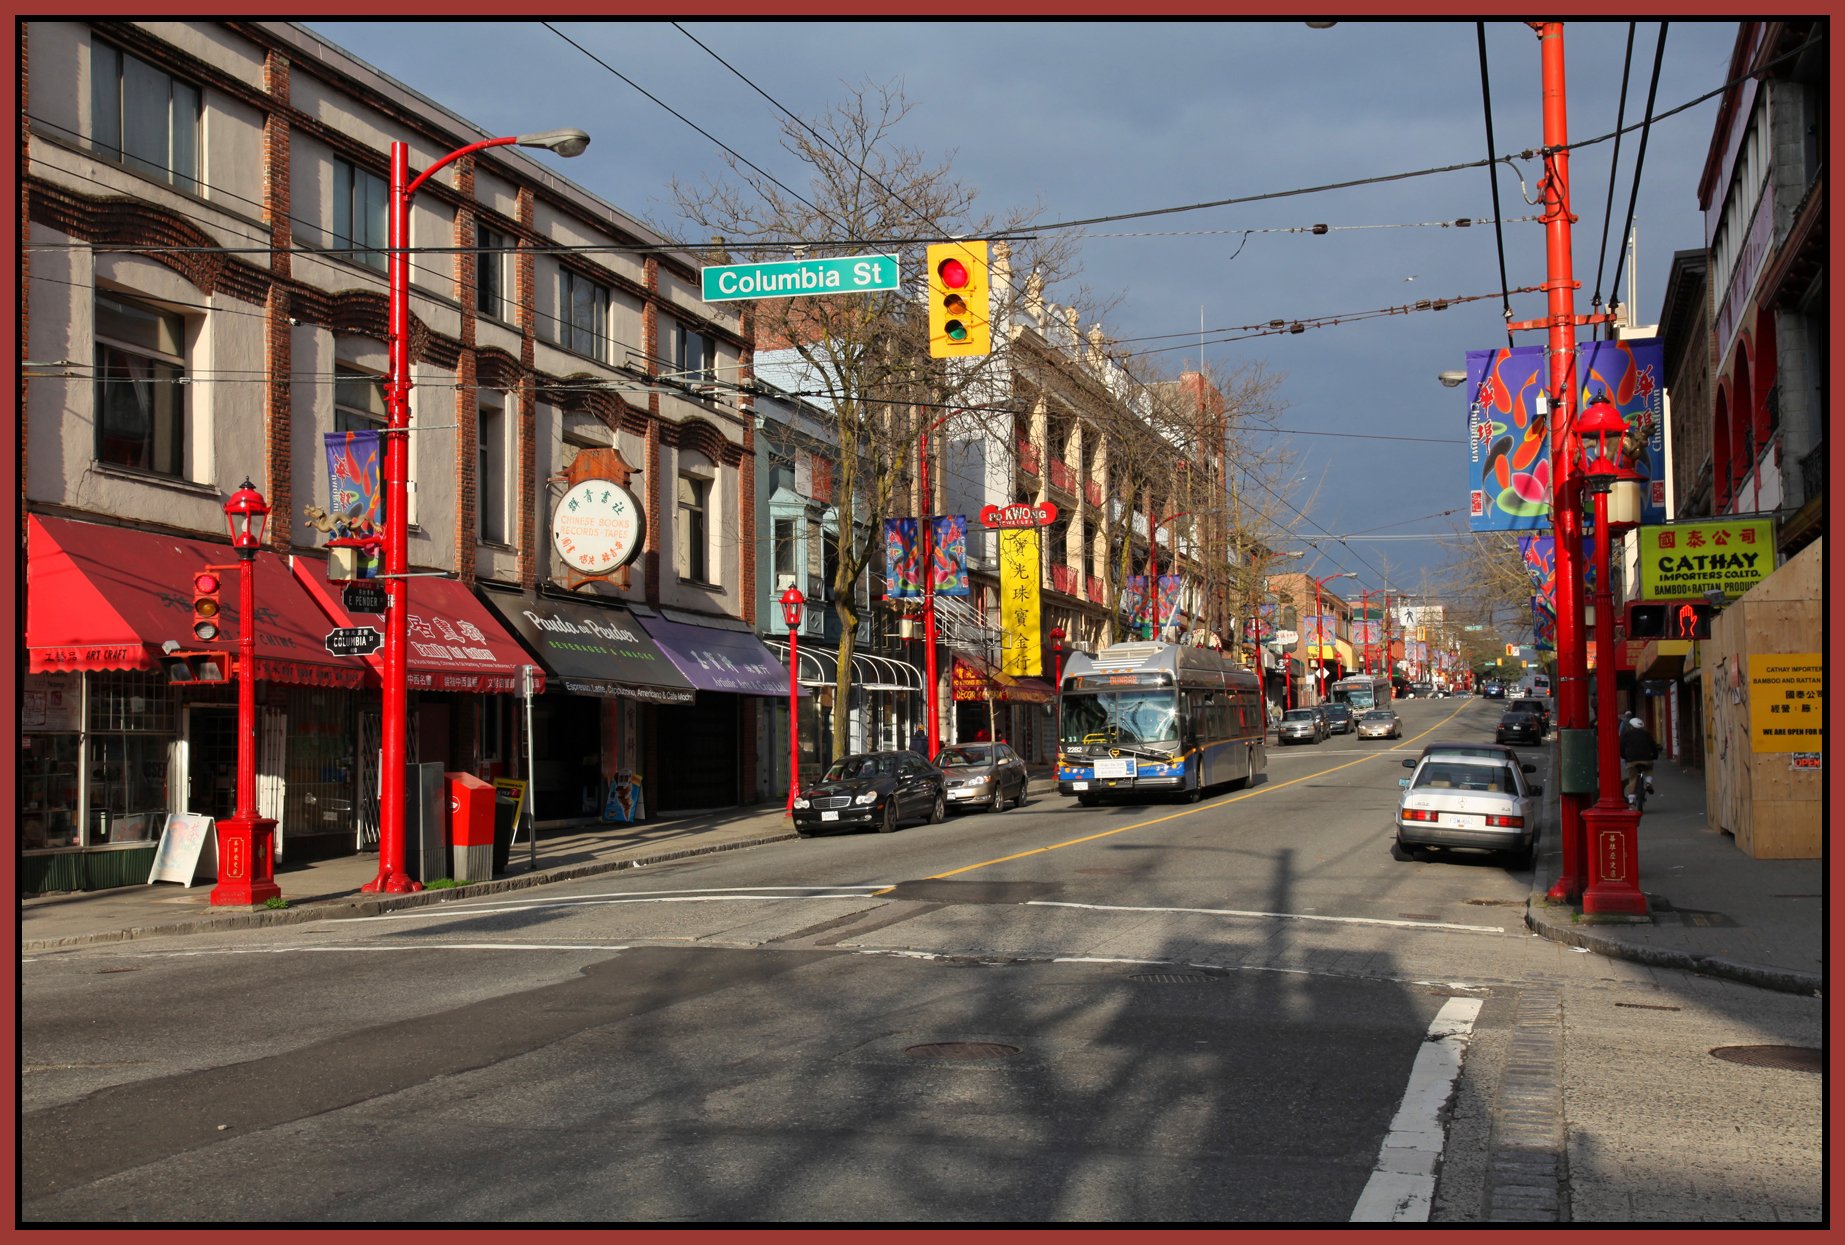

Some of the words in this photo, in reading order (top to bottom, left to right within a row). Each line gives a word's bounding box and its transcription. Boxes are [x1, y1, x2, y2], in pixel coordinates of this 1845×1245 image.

[718, 265, 840, 295] Columbia
[853, 262, 882, 286] St
[1652, 388, 1662, 452] Chinatown
[1471, 401, 1479, 463] Chinatown
[1005, 506, 1047, 522] KWONG
[560, 515, 595, 526] CHINESE
[599, 518, 630, 529] BOOKS
[560, 525, 599, 537] RECORDS
[604, 529, 628, 539] TAPES
[1658, 528, 1756, 549] 國泰公司
[1658, 552, 1759, 573] CATHAY
[1659, 571, 1723, 582] IMPORTERS
[1654, 584, 1687, 595] BAMBOO
[1724, 581, 1760, 593] PRODUC
[355, 596, 378, 607] PENDER
[523, 610, 580, 635] Panda
[577, 624, 593, 635] on
[583, 619, 640, 643] Pender
[333, 636, 367, 648] COLUMBIA
[86, 650, 101, 661] ART
[103, 649, 128, 661] CRAFT
[547, 640, 608, 655] BEVERAGES
[619, 650, 655, 661] SNACKS
[1077, 677, 1084, 689] 7
[637, 689, 662, 699] Americano
[1794, 758, 1821, 769] OPEN
